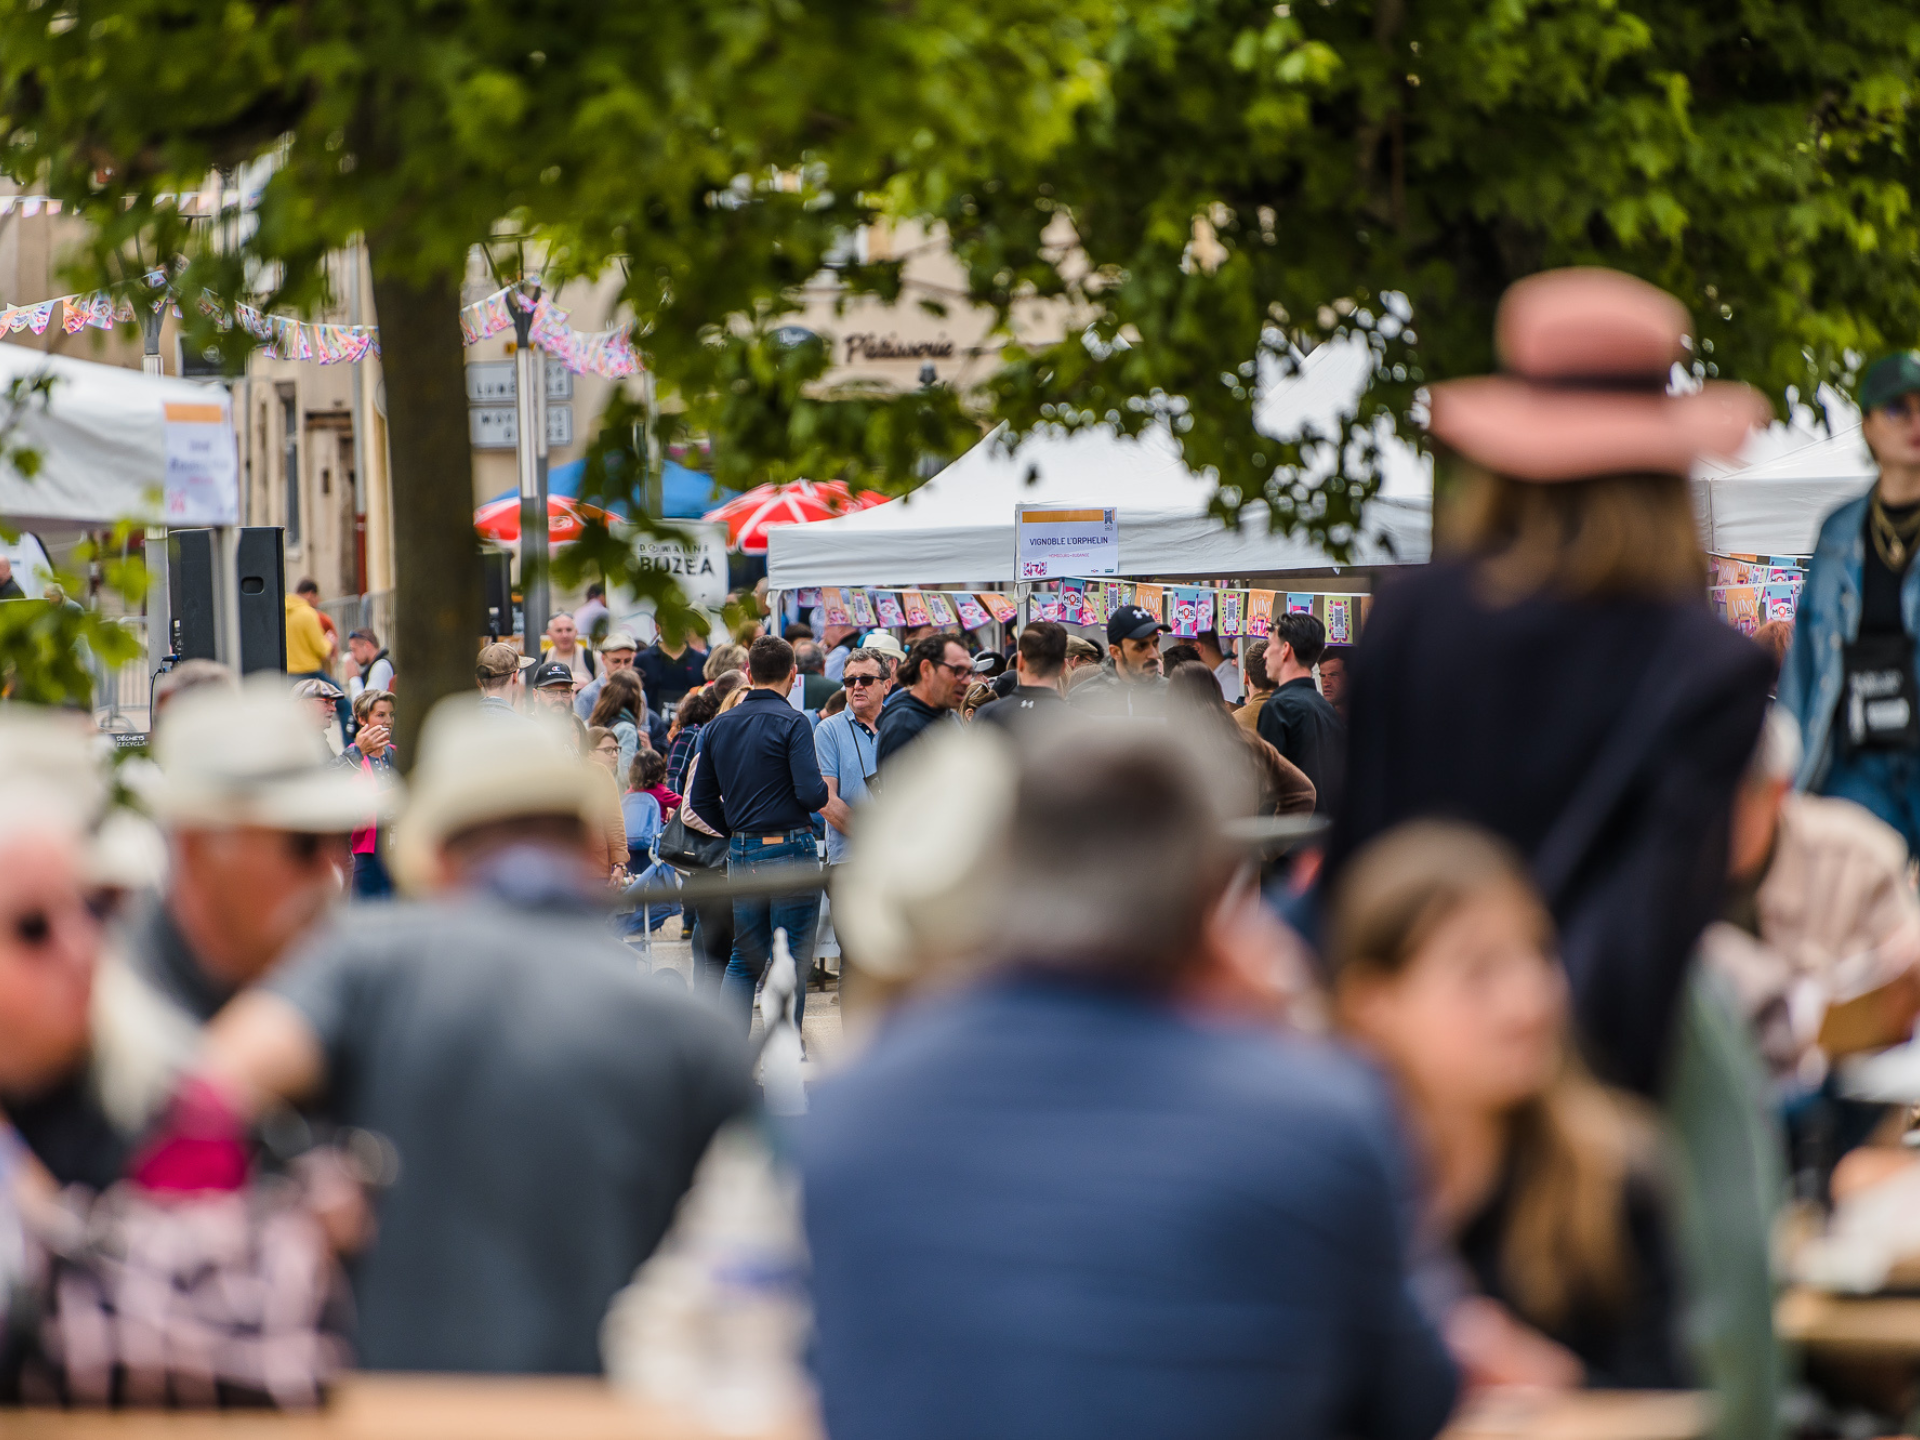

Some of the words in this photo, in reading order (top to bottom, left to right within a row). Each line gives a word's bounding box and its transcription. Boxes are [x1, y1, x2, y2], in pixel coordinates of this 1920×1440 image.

[1029, 537, 1066, 546] VIGNOBLE
[1067, 536, 1108, 545] L'ORPHELIN
[1140, 594, 1160, 613] VINS
[1731, 599, 1754, 617] VINS
[1771, 605, 1794, 618] MOSL
